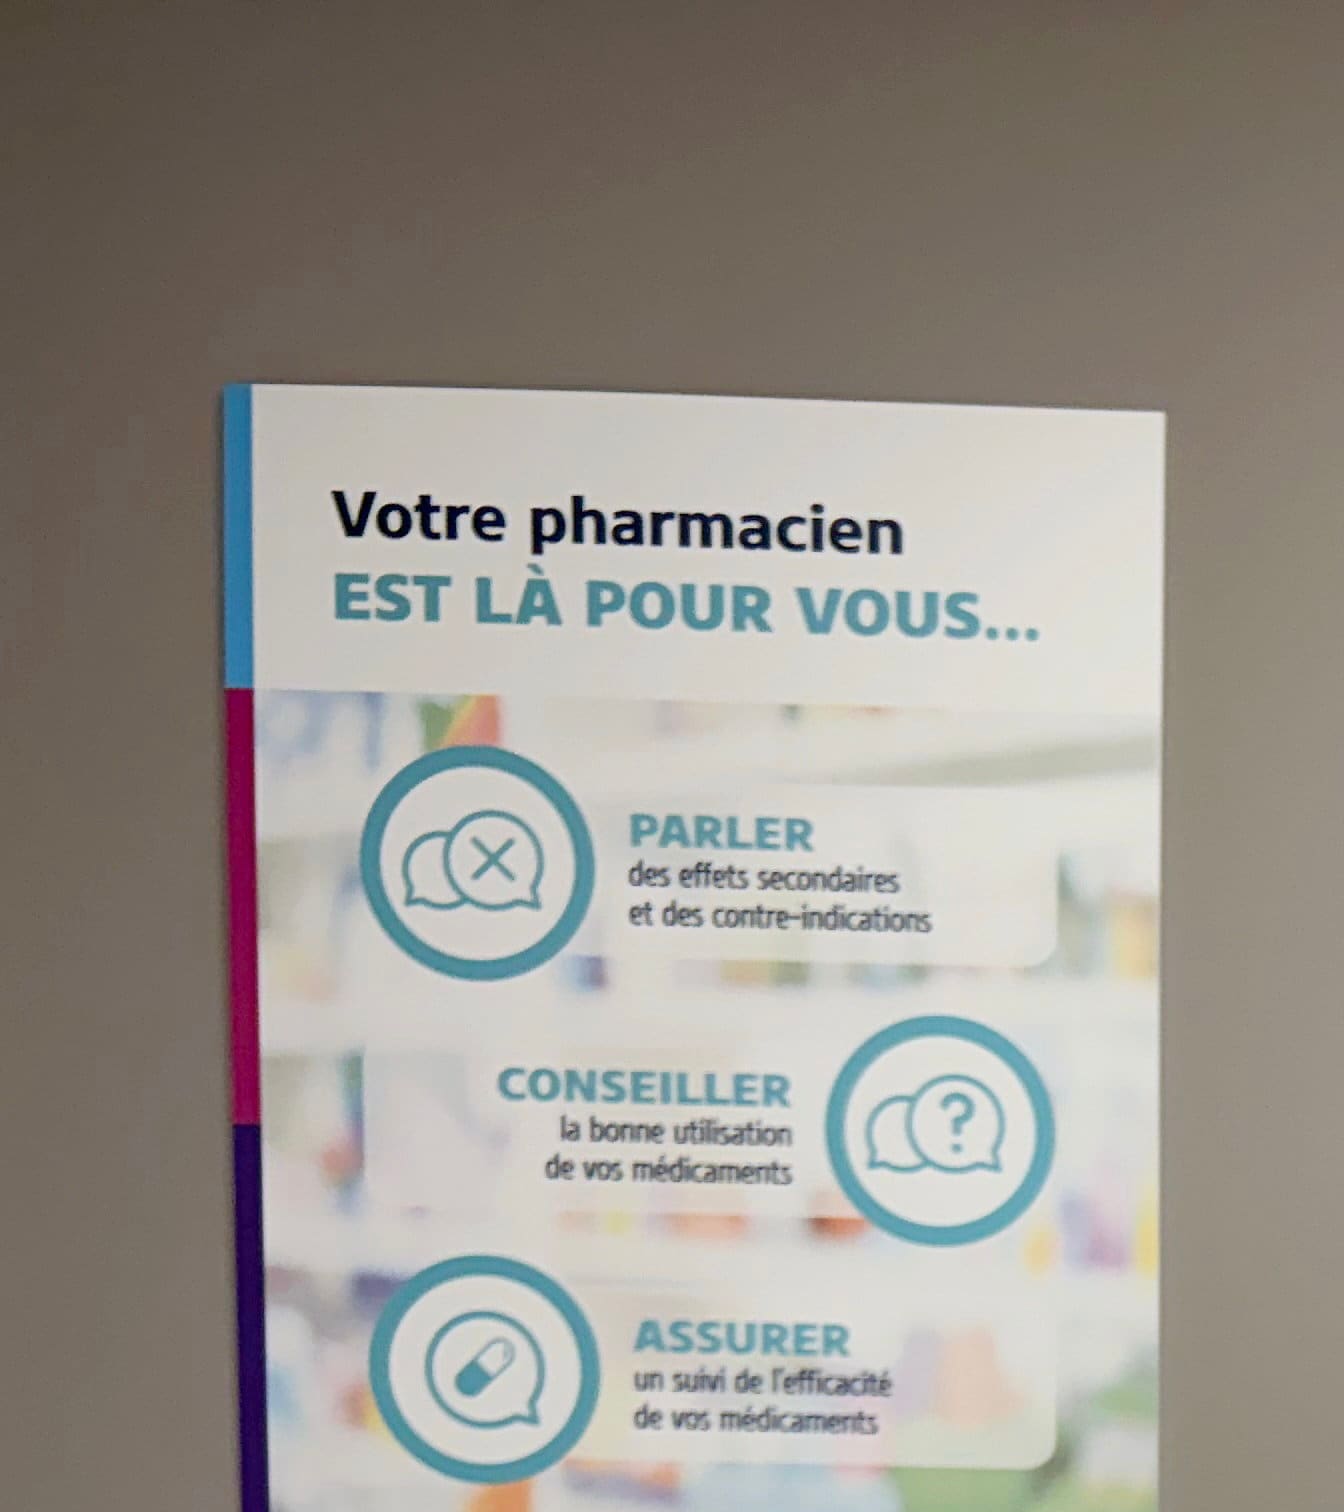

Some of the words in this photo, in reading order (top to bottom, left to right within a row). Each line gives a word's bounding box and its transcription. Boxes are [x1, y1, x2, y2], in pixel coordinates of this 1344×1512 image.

[330, 489, 507, 542] Votre
[529, 495, 903, 556] pharmacien
[334, 572, 452, 623] EST
[475, 565, 563, 626] LÀ
[585, 579, 773, 633] POUR
[629, 812, 814, 852] PARLER
[627, 858, 672, 888] des
[677, 860, 750, 890] effets
[756, 865, 901, 894] secondaires
[627, 900, 654, 927] et
[660, 899, 705, 928] des
[710, 903, 933, 934] contre-indications
[497, 1066, 791, 1108] CONSEILLER
[559, 1114, 582, 1142] la
[588, 1115, 666, 1145] bonne
[672, 1117, 793, 1147] utilisation
[544, 1152, 576, 1181] de
[581, 1159, 625, 1182] vos
[630, 1155, 793, 1186] médicaments
[633, 1319, 849, 1357] ASSURER
[633, 1370, 665, 1392] un
[671, 1367, 727, 1393] suivi
[733, 1368, 764, 1395] de
[632, 1403, 664, 1430] de
[669, 1409, 712, 1432] vos
[718, 1405, 879, 1435] médicaments
